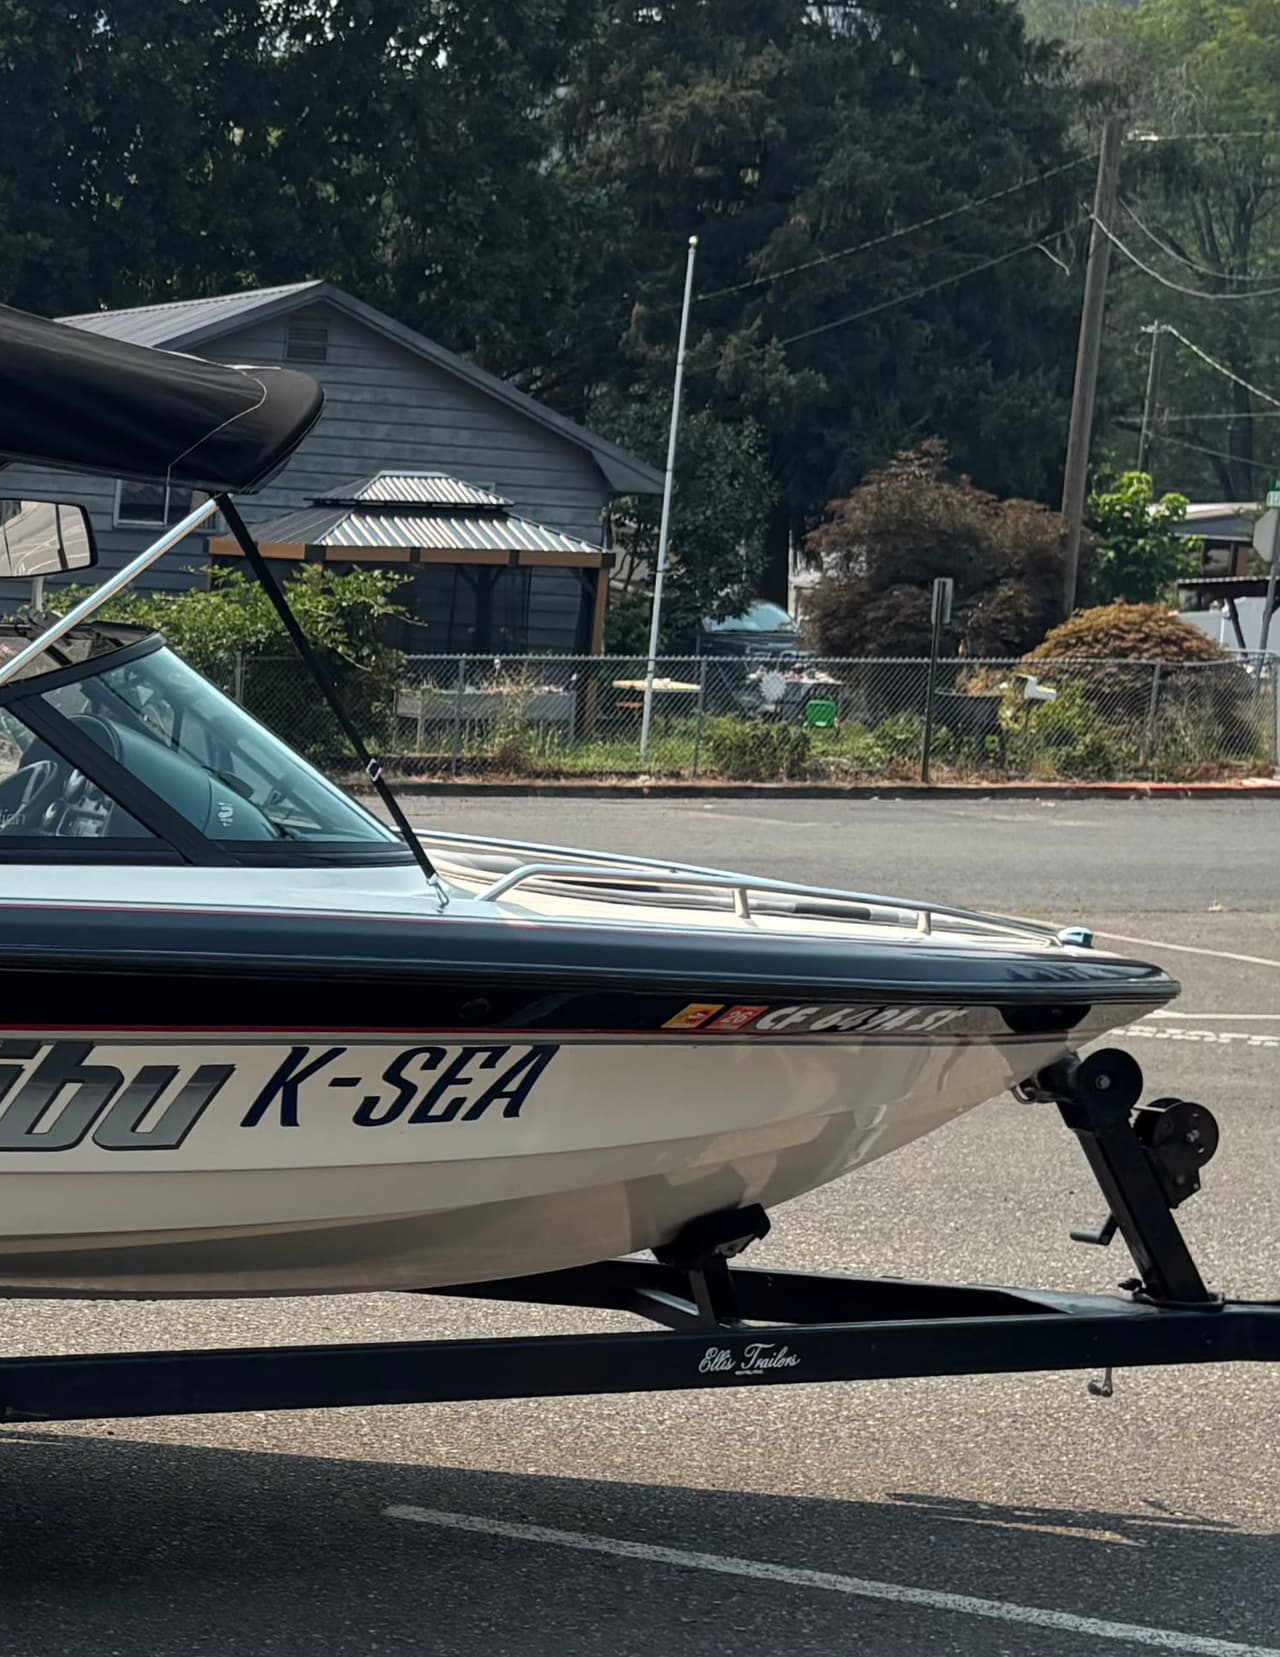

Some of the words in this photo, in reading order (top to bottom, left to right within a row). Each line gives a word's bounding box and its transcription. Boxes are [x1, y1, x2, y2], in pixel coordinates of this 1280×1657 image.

[756, 1006, 821, 1031] CF
[239, 1043, 561, 1128] K-SEA
[698, 1346, 736, 1373] Ellis
